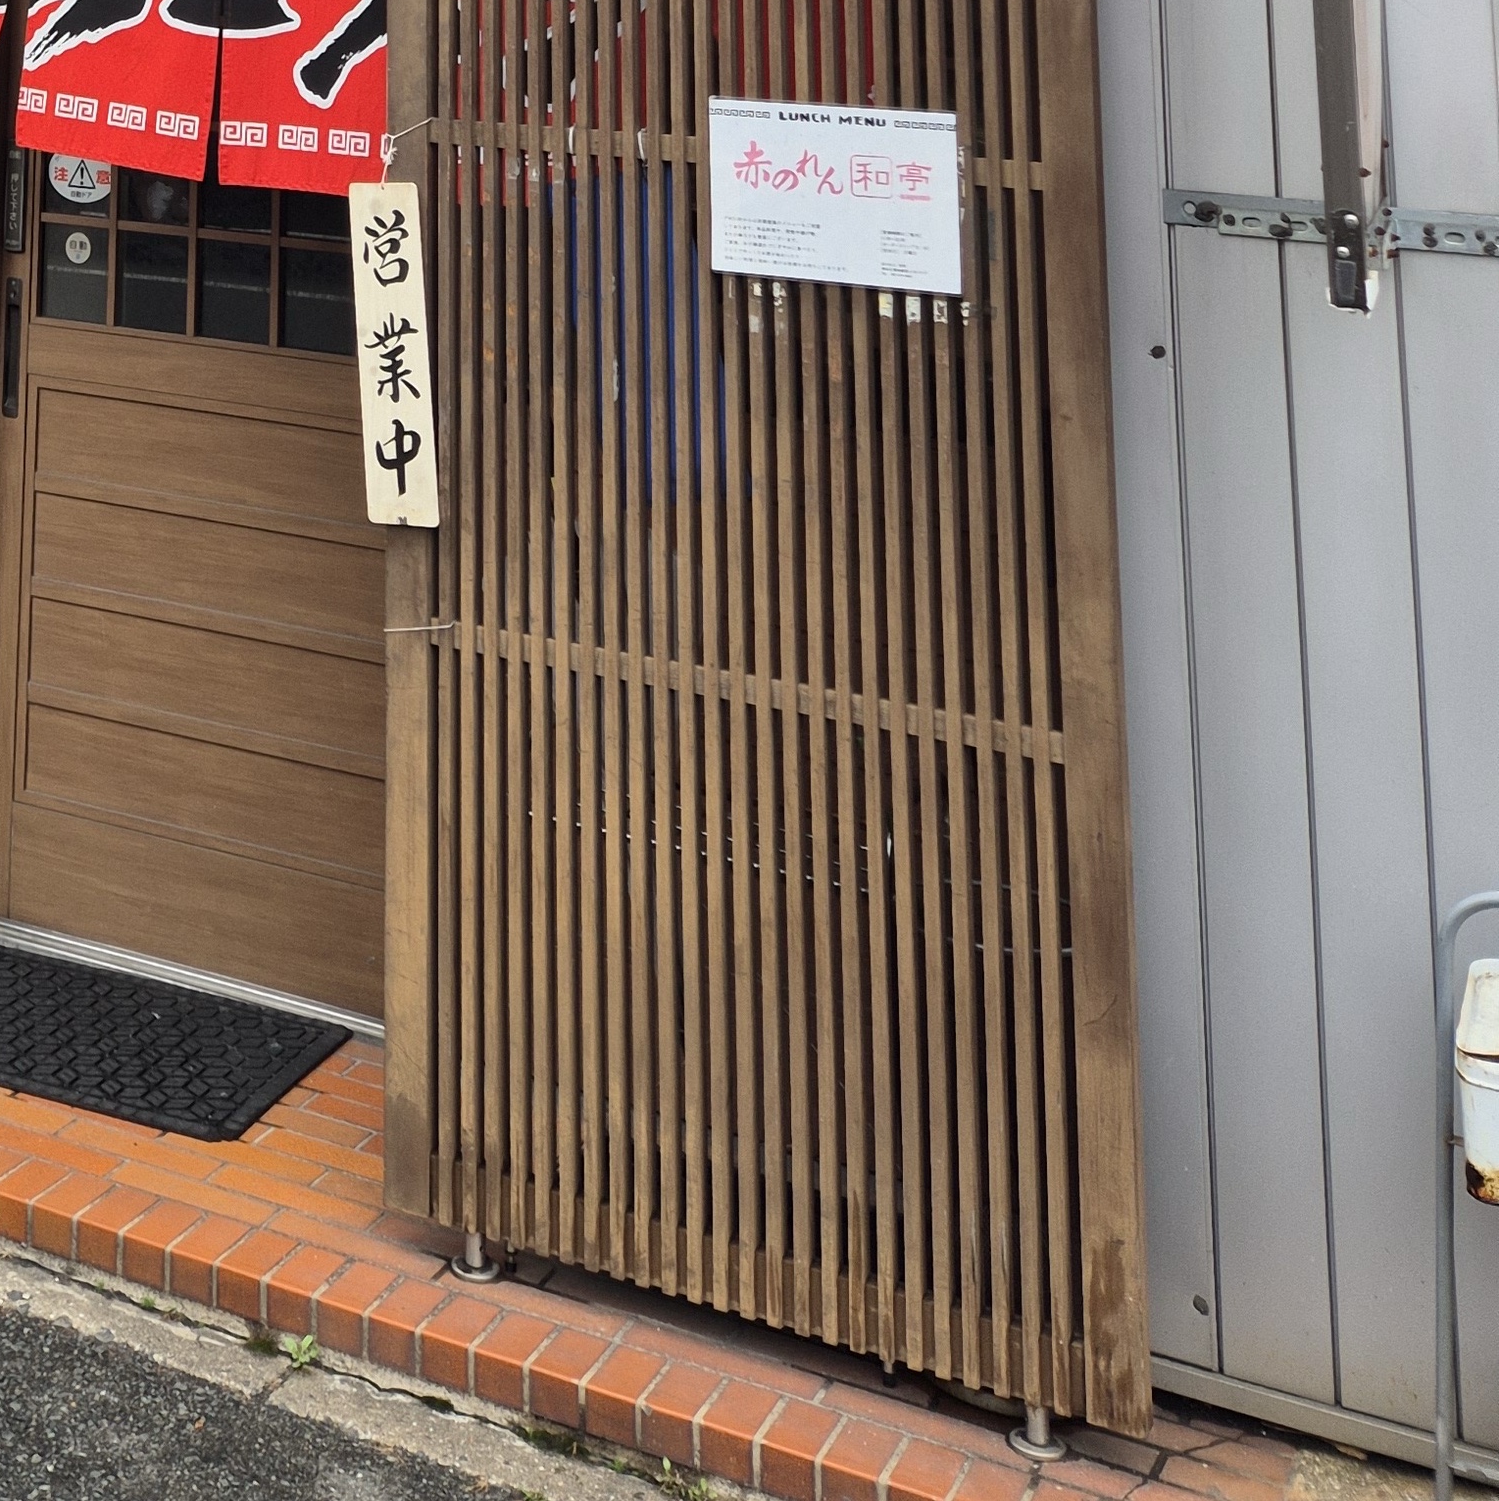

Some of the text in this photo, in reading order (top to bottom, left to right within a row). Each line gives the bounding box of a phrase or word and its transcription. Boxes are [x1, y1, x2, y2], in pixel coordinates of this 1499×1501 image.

[778, 111, 887, 128] LUNCH MENU
[733, 140, 844, 196] 赤のれん
[362, 208, 422, 498] 営業中
